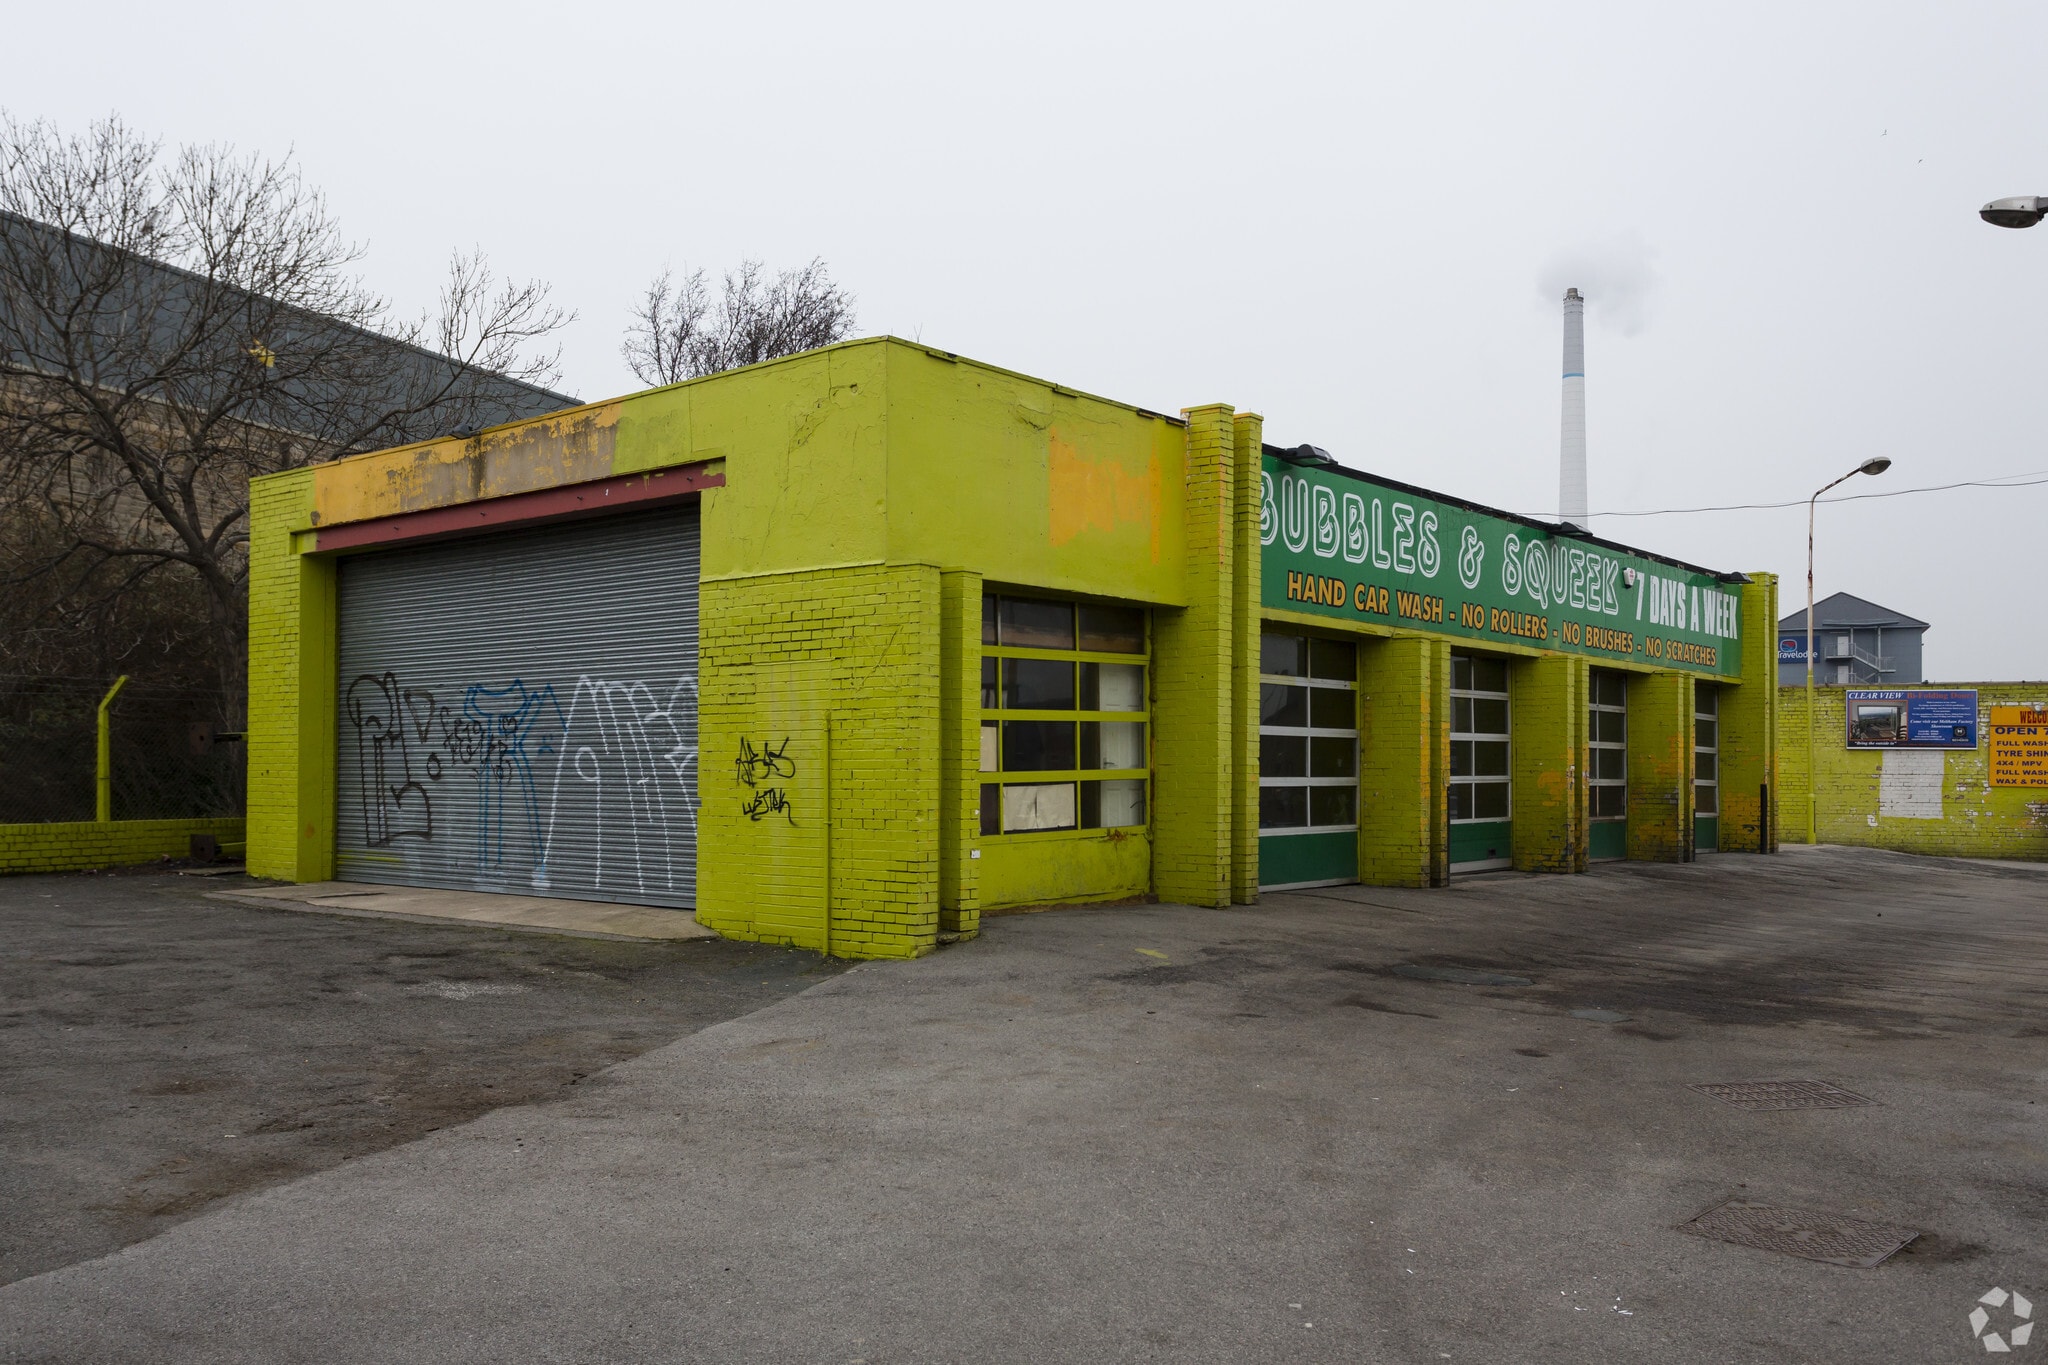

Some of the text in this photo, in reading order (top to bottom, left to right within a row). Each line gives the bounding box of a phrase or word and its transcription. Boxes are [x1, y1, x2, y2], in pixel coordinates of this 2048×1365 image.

[1260, 470, 1619, 616] BUBBLES & SQUEEK
[1287, 570, 1346, 607] HAND
[1354, 582, 1390, 615] CAR
[1396, 589, 1444, 624] WASH
[1461, 602, 1486, 630] NO
[1490, 606, 1548, 642] ROLLERS
[1562, 620, 1581, 646] NO
[1585, 623, 1633, 654] BRUSHES
[1645, 635, 1662, 658] NO
[1666, 641, 1717, 667] SCRATCHES
[1636, 571, 1738, 640] 7 DAYS A WEEK
[1778, 650, 1818, 659] Travelode
[1995, 727, 2037, 736] OPEN
